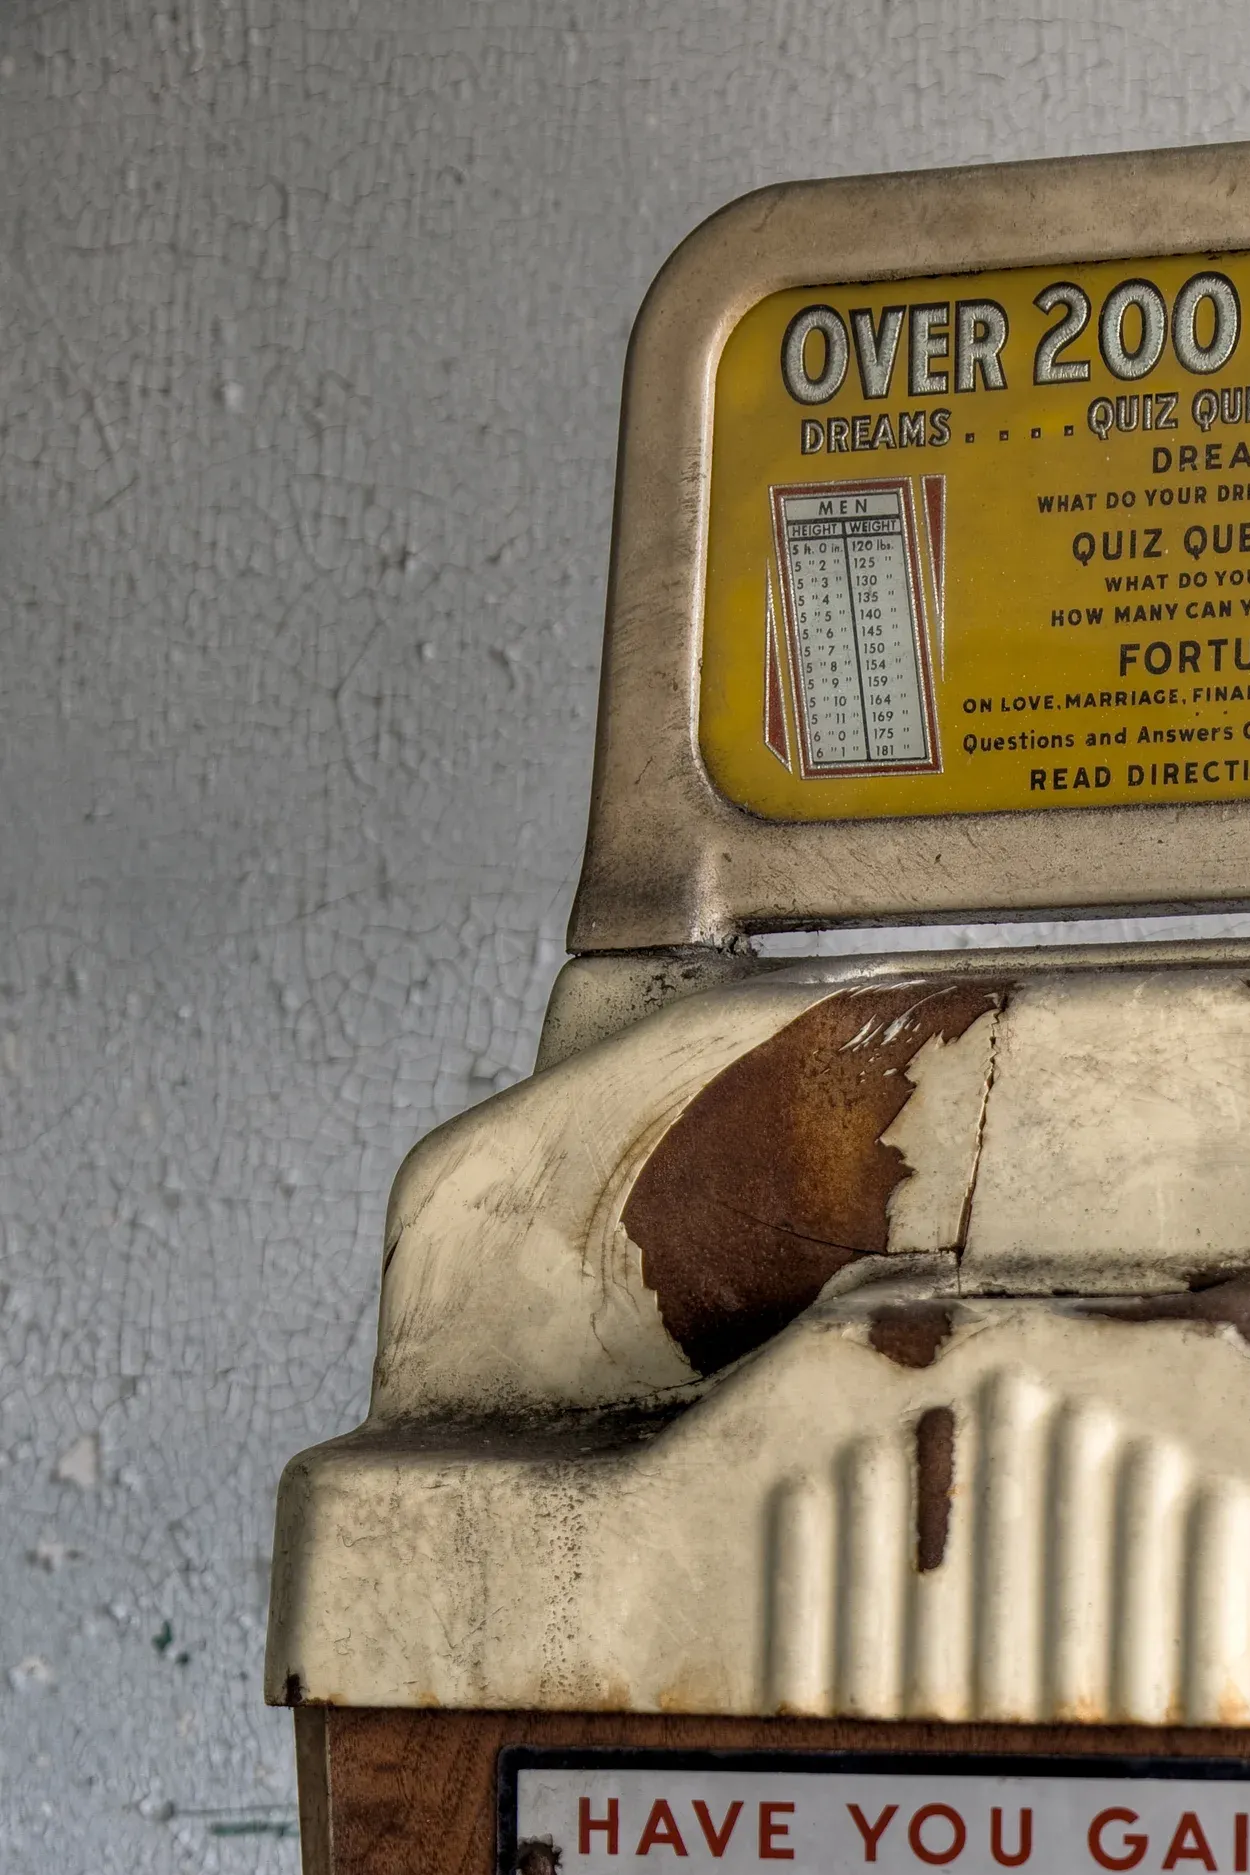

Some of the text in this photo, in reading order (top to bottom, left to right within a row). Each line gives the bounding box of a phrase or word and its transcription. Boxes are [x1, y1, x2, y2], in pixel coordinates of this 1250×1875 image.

[781, 297, 1010, 406] OVER
[1032, 270, 1241, 387] 200
[800, 409, 952, 456] DREAMS
[1087, 391, 1179, 441] QUIZ
[818, 498, 867, 515] MEN
[1037, 493, 1097, 513] WHAT
[1106, 491, 1136, 509] DO
[1144, 486, 1207, 506] YOUR
[791, 520, 897, 537] HEIGHT WEIGHT
[792, 544, 799, 556] 5
[819, 542, 827, 553] 0
[852, 540, 873, 552] 120
[1072, 528, 1162, 567] QUIZ
[795, 556, 875, 572] 5 2 125
[797, 575, 877, 590] 5 3 130
[1104, 574, 1169, 592] WHAT
[1179, 571, 1207, 588] DO
[798, 592, 878, 607] 5 4 135
[800, 608, 881, 624] 5 5 140
[1051, 608, 1103, 627] HOW
[1115, 603, 1178, 623] MANY
[1185, 600, 1232, 619] CAN
[802, 625, 882, 640] 5 6 145
[804, 642, 885, 658] 5 7 150
[806, 659, 886, 674] 5 8 154
[807, 675, 888, 690] 5 9 159
[809, 694, 891, 708] 5 10 164
[963, 698, 992, 713] ON
[811, 711, 894, 725] 5 11 169
[813, 728, 894, 742] 6 0 175
[963, 729, 1074, 755] Questions
[1085, 727, 1127, 746] and
[1137, 726, 1233, 743] Answers
[816, 745, 894, 759] 6 1 181
[1030, 766, 1111, 791] READ
[578, 1797, 795, 1860] HAVE
[846, 1803, 1033, 1867] YOU
